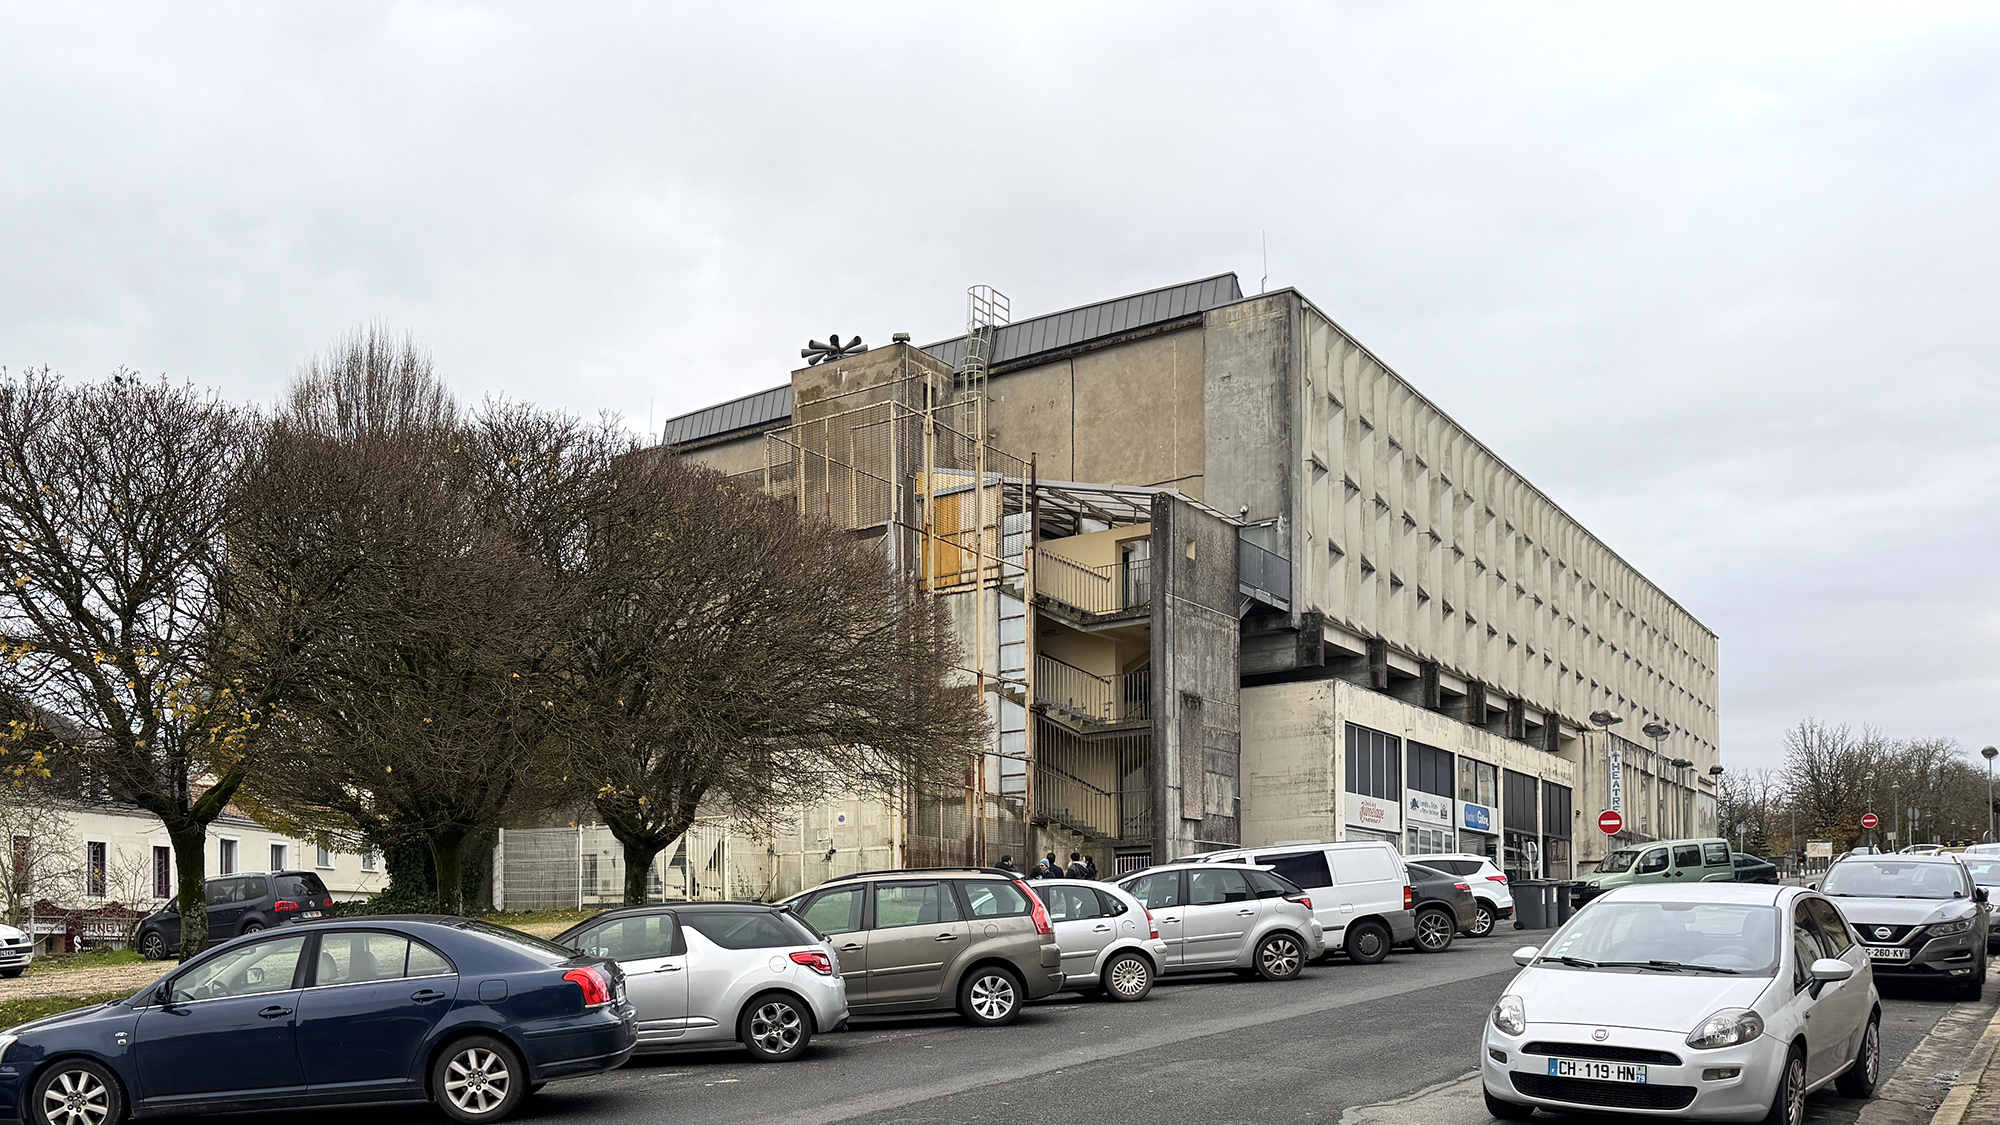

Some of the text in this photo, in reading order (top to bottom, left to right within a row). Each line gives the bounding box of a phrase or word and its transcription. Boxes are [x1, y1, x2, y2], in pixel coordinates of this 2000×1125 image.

[1612, 753, 1621, 814] THEATRE
[1863, 948, 1904, 958] G-260-KV
[1559, 1061, 1635, 1081] CH-119-HN
